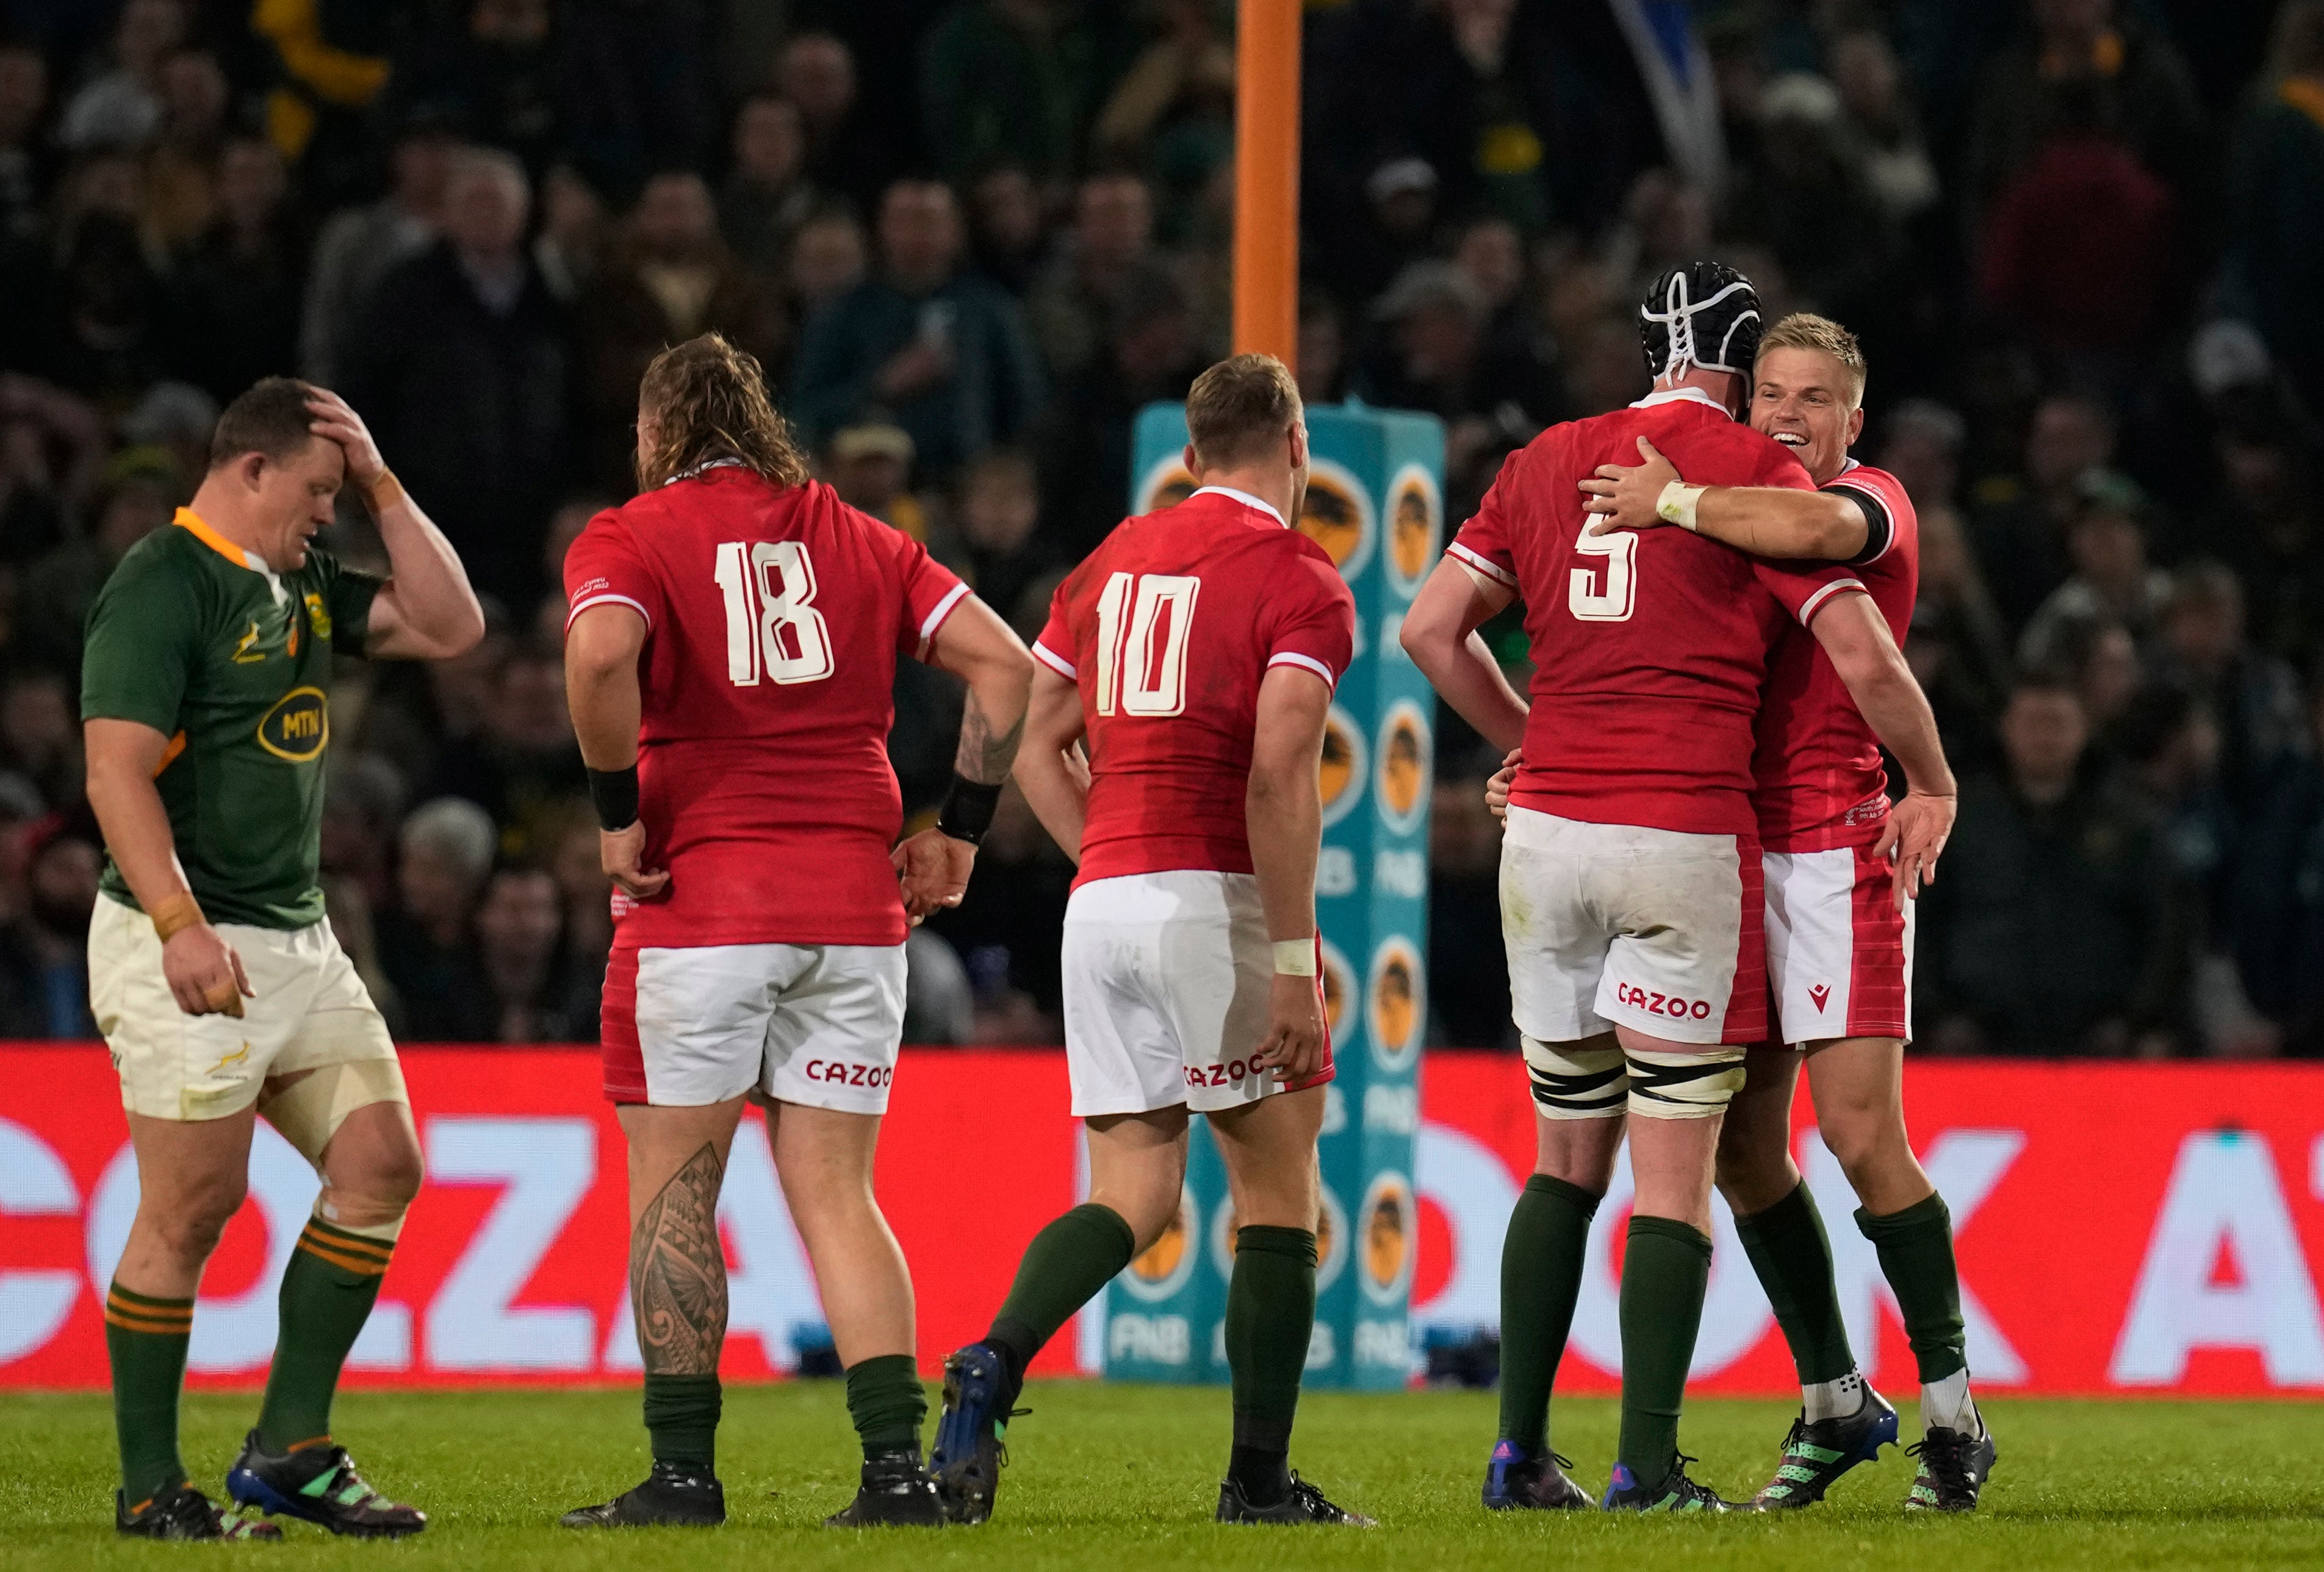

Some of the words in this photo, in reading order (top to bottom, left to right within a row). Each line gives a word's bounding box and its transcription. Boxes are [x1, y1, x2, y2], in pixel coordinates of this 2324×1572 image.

[715, 541, 834, 687] 18
[1569, 494, 1638, 621] 5
[1096, 571, 1201, 717] 10
[282, 708, 318, 740] MTN
[1619, 982, 1710, 1019] CAZOO
[806, 1060, 891, 1087] CAZOO
[2106, 1129, 2324, 1386] A
